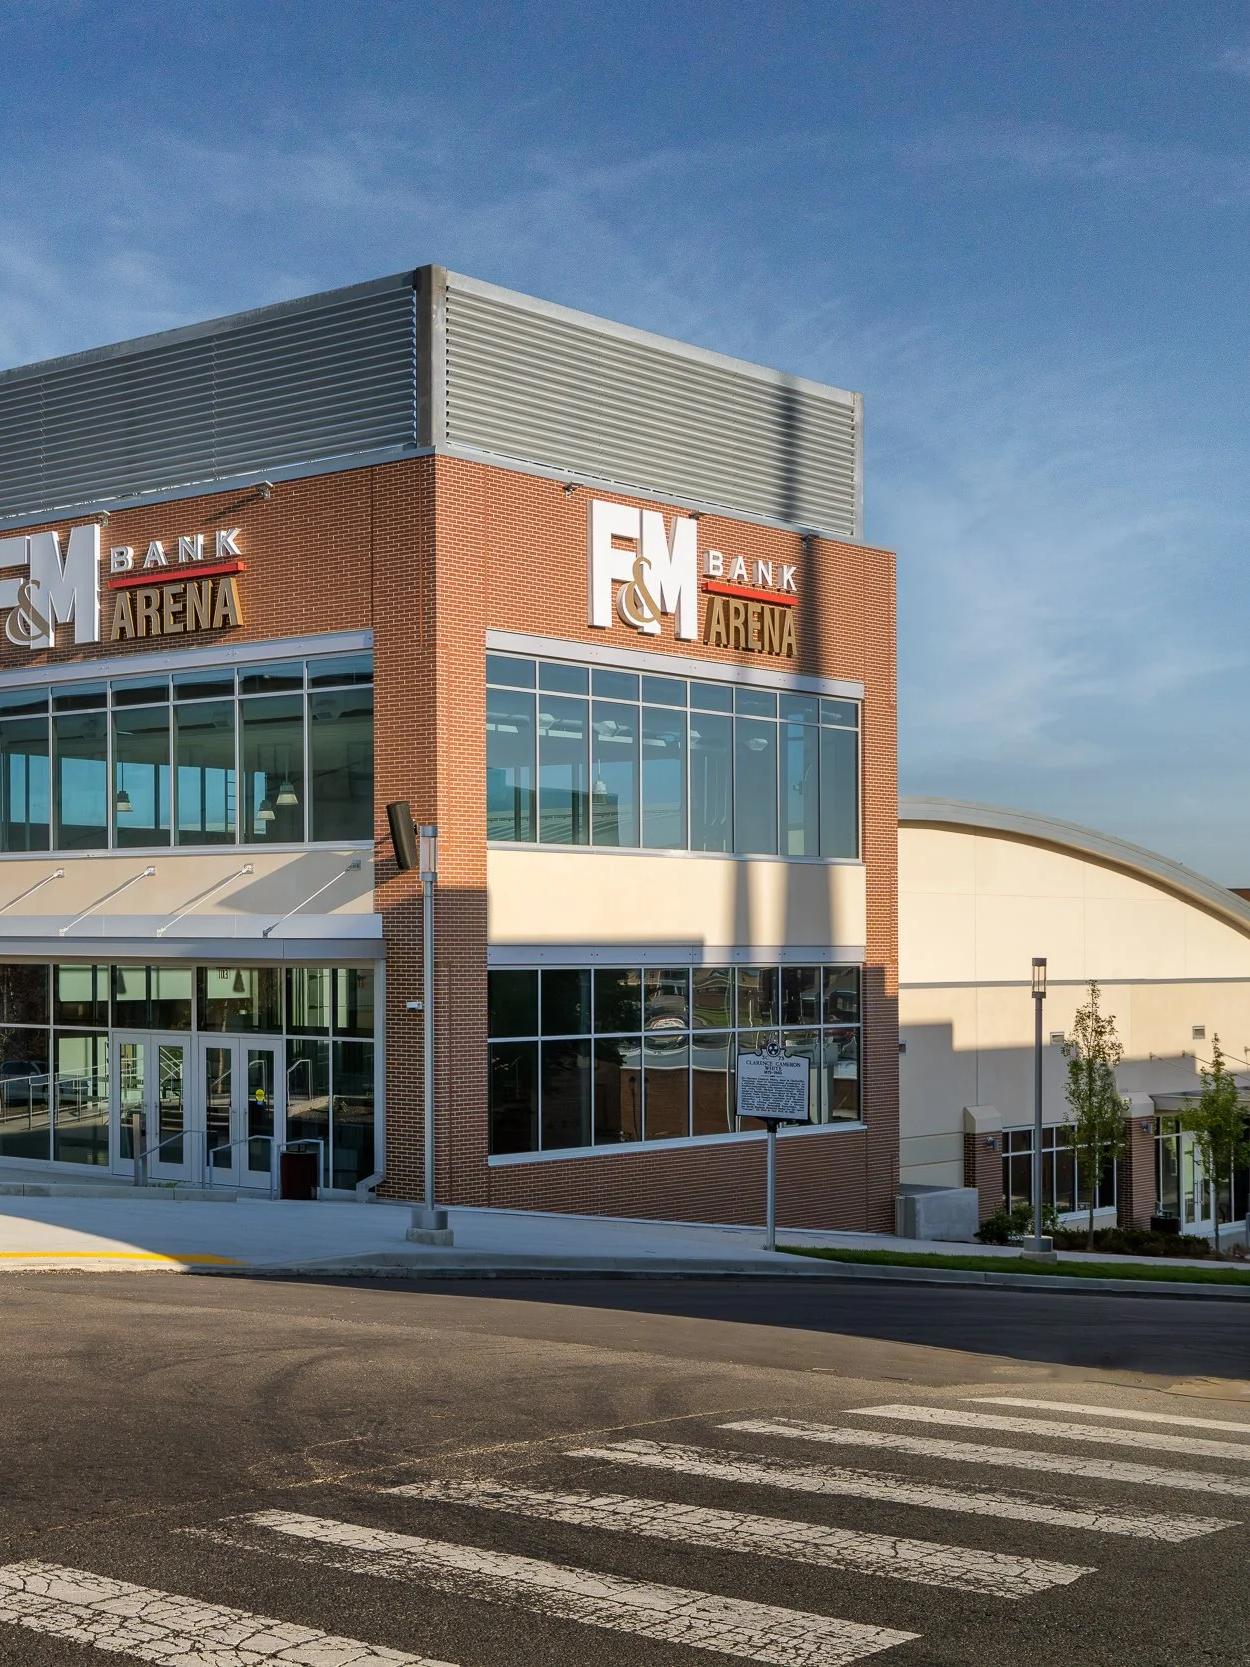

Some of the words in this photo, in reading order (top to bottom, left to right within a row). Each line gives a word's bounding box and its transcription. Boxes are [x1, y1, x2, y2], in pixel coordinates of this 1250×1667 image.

[110, 528, 242, 573] BANK
[587, 499, 698, 641] F&M
[705, 550, 797, 591] BANK
[111, 577, 244, 640] ARENA
[705, 597, 797, 656] ARENA
